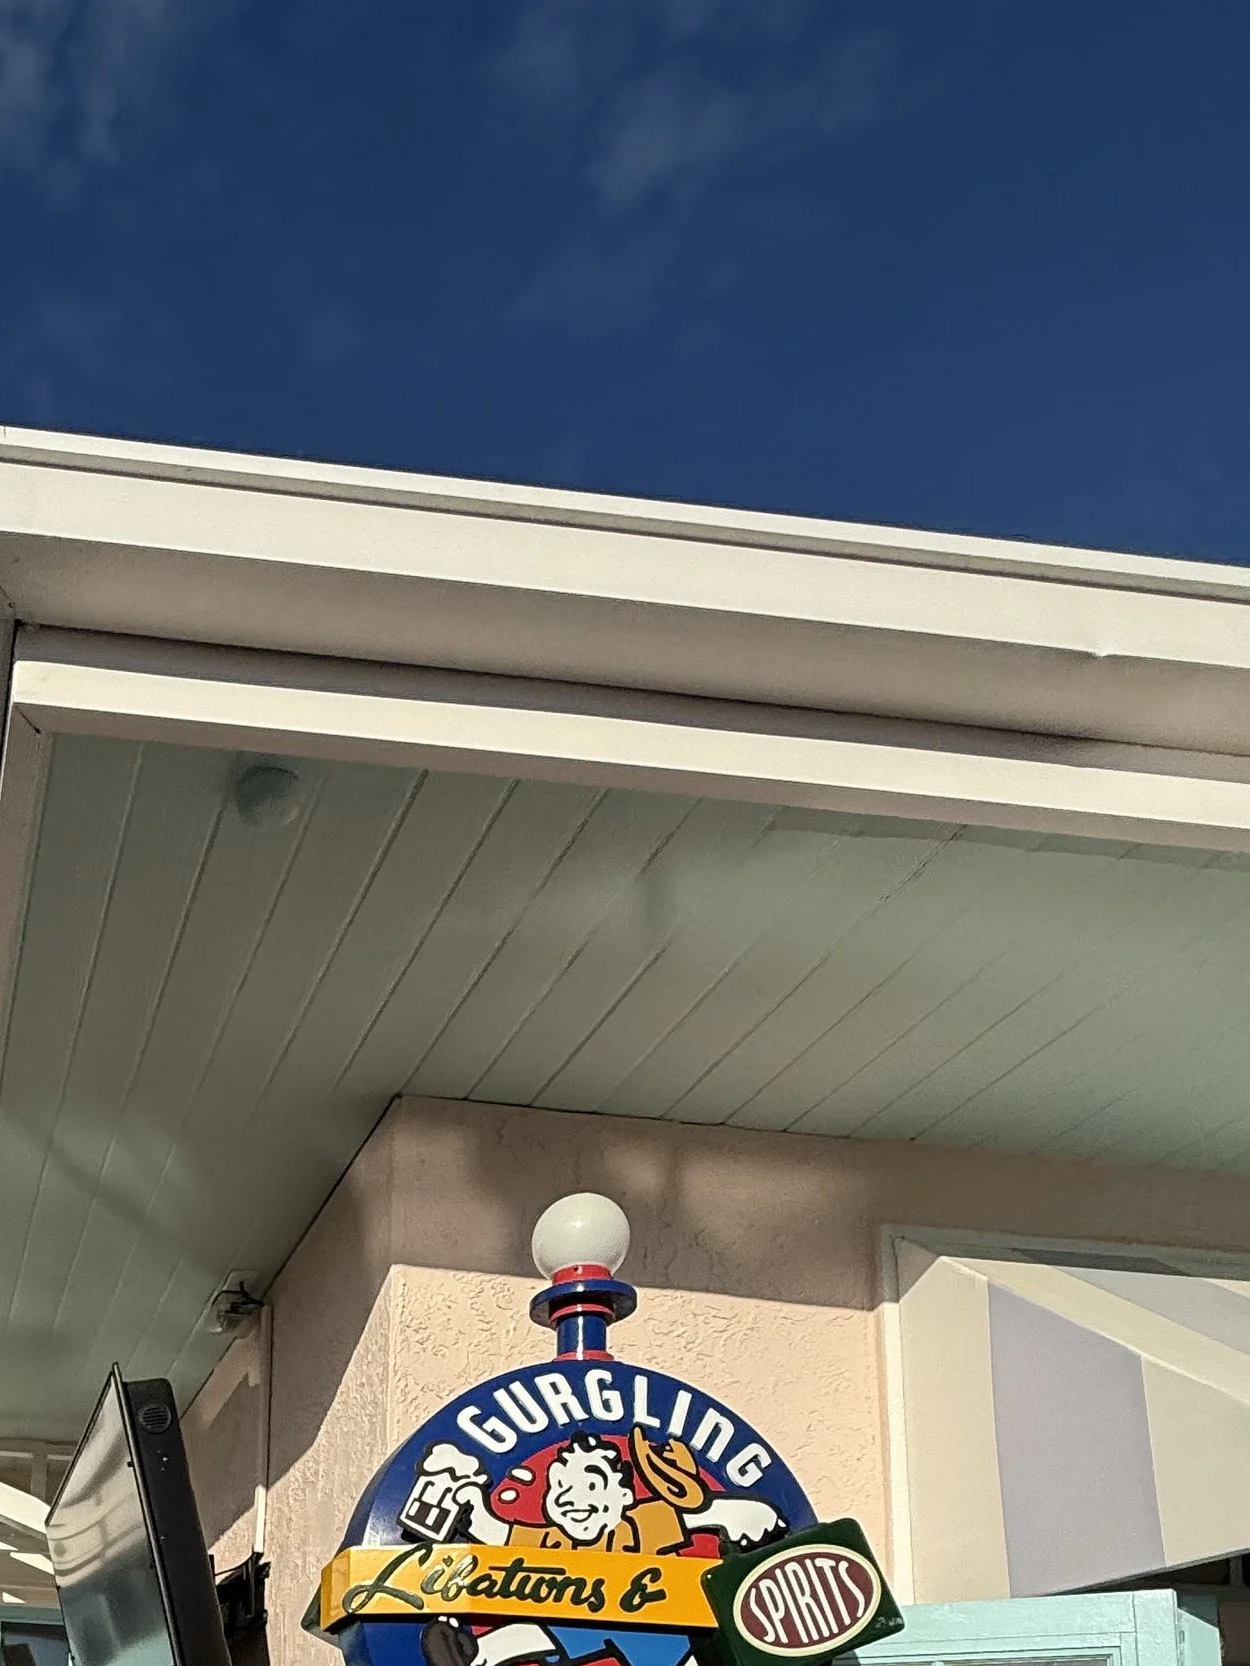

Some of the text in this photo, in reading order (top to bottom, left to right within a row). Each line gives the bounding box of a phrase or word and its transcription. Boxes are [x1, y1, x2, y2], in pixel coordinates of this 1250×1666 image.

[456, 1368, 774, 1488] GURGLING
[343, 1542, 866, 1645] Libations & SPIRITS
